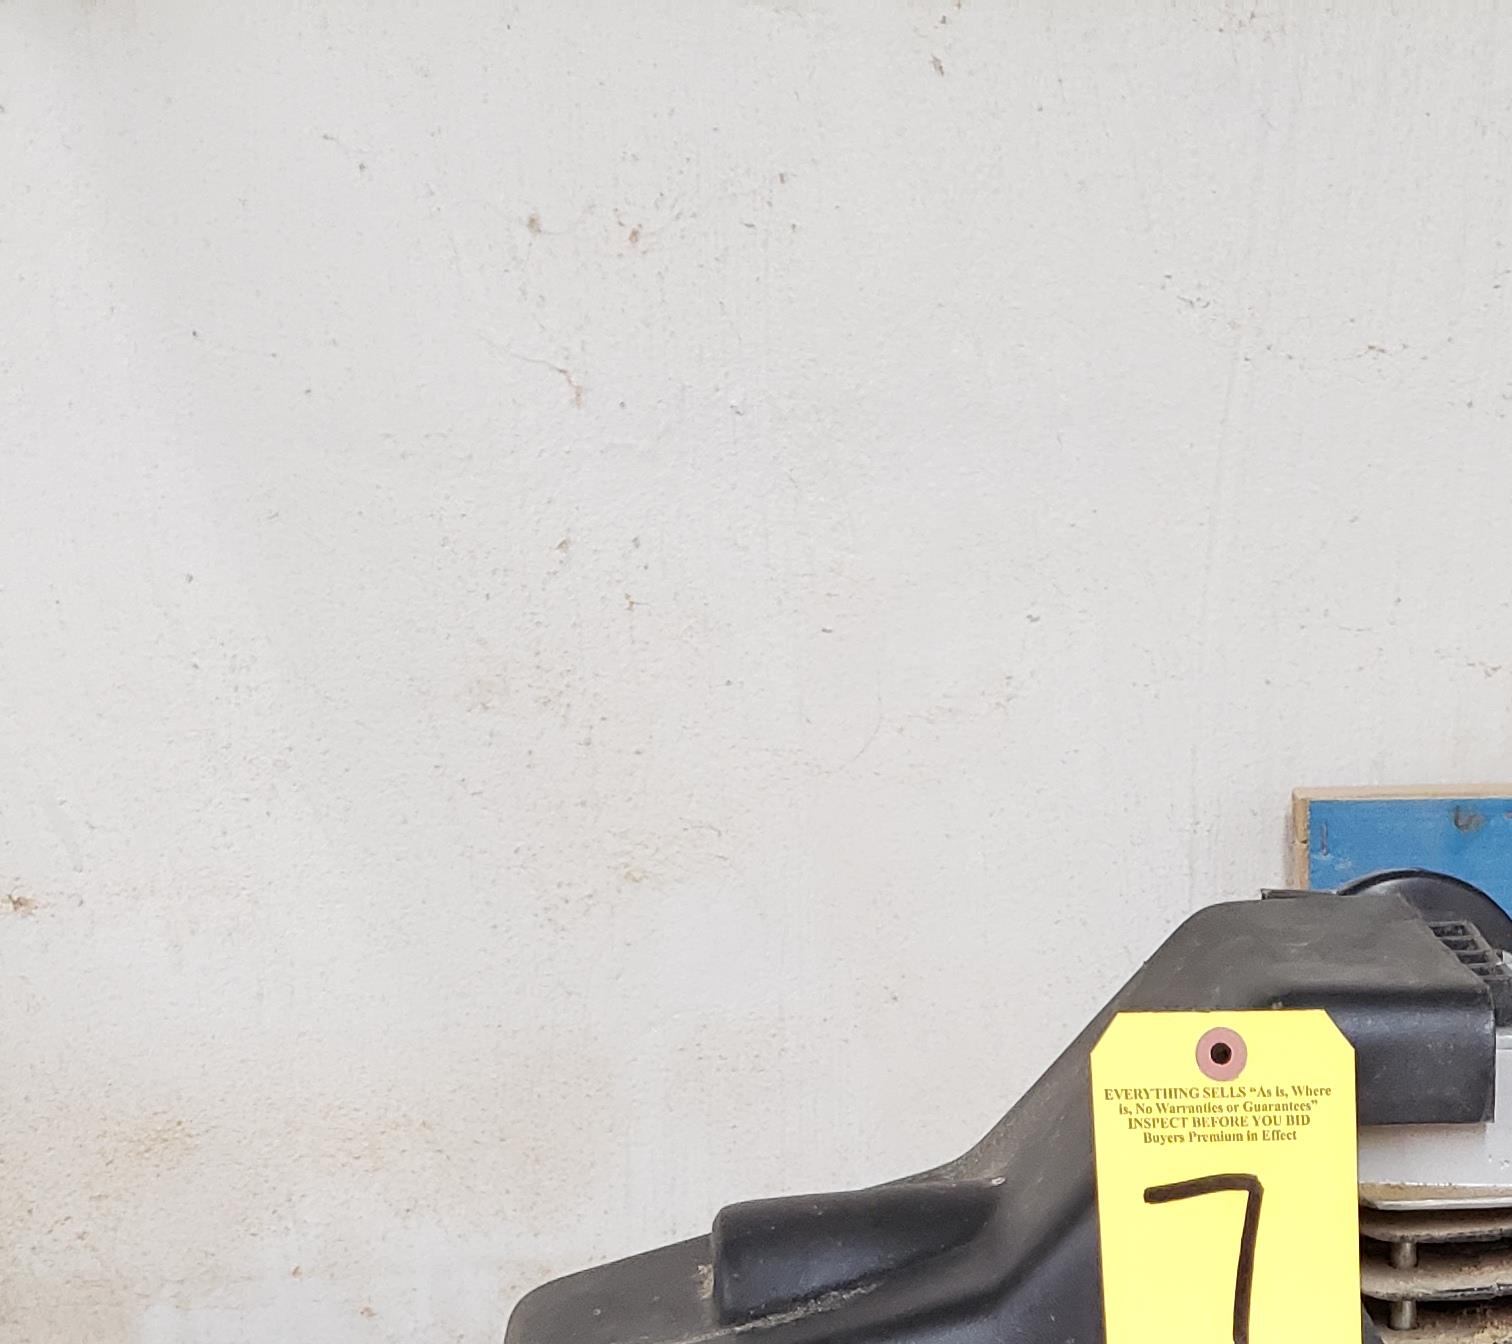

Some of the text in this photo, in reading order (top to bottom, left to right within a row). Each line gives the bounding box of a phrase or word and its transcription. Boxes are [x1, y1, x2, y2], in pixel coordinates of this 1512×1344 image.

[1104, 1087, 1200, 1100] EVERYTHING
[1203, 1086, 1246, 1098] SELLS
[1291, 1085, 1332, 1096] Where
[1136, 1103, 1153, 1114] No
[1156, 1102, 1223, 1114] Warranties
[1226, 1104, 1240, 1113] or
[1128, 1114, 1311, 1130] INSPECT BEFORE YOU BID
[1143, 1129, 1297, 1146] Buyers Premium in Effect
